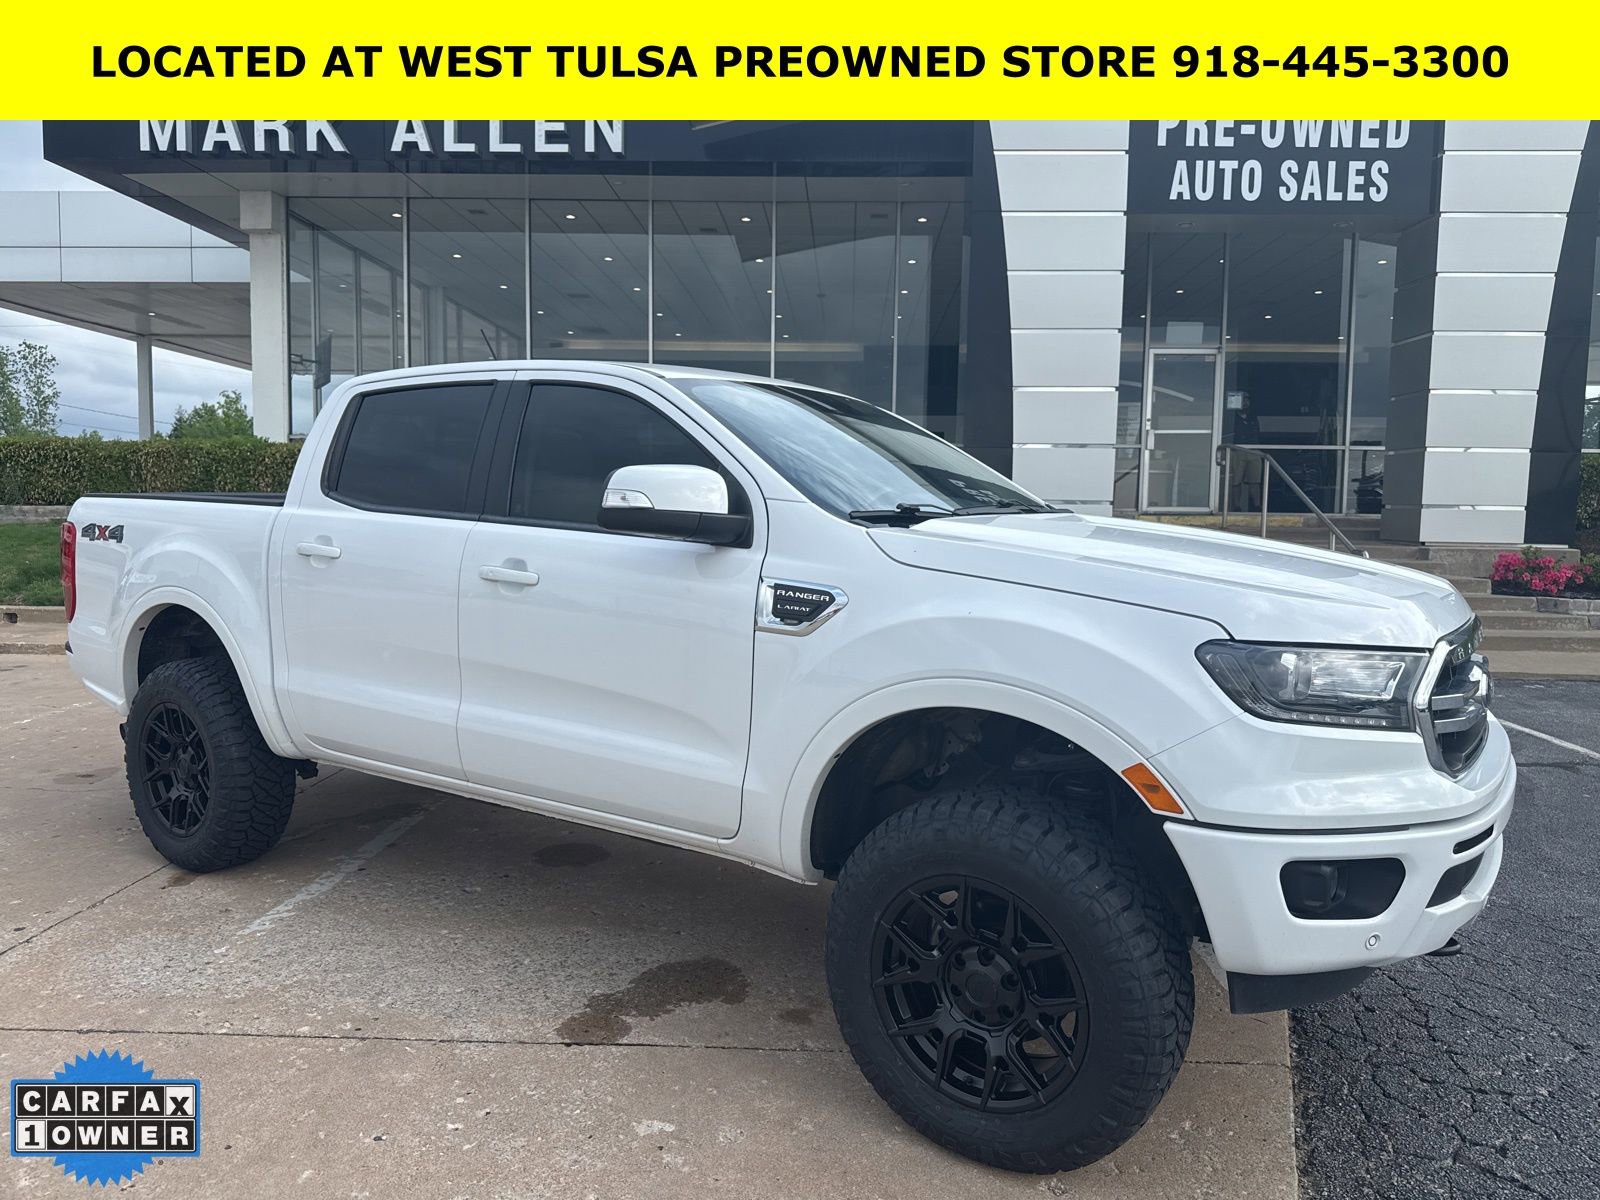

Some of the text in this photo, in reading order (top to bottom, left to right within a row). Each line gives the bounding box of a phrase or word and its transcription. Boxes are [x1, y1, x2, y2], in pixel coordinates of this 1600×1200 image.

[139, 120, 625, 154] MARK ALLEN
[1157, 120, 1410, 148] PRE-OWNED
[1169, 159, 1390, 202] AUTO SALES
[776, 589, 830, 602] RANGER
[777, 604, 811, 612] LARIAT
